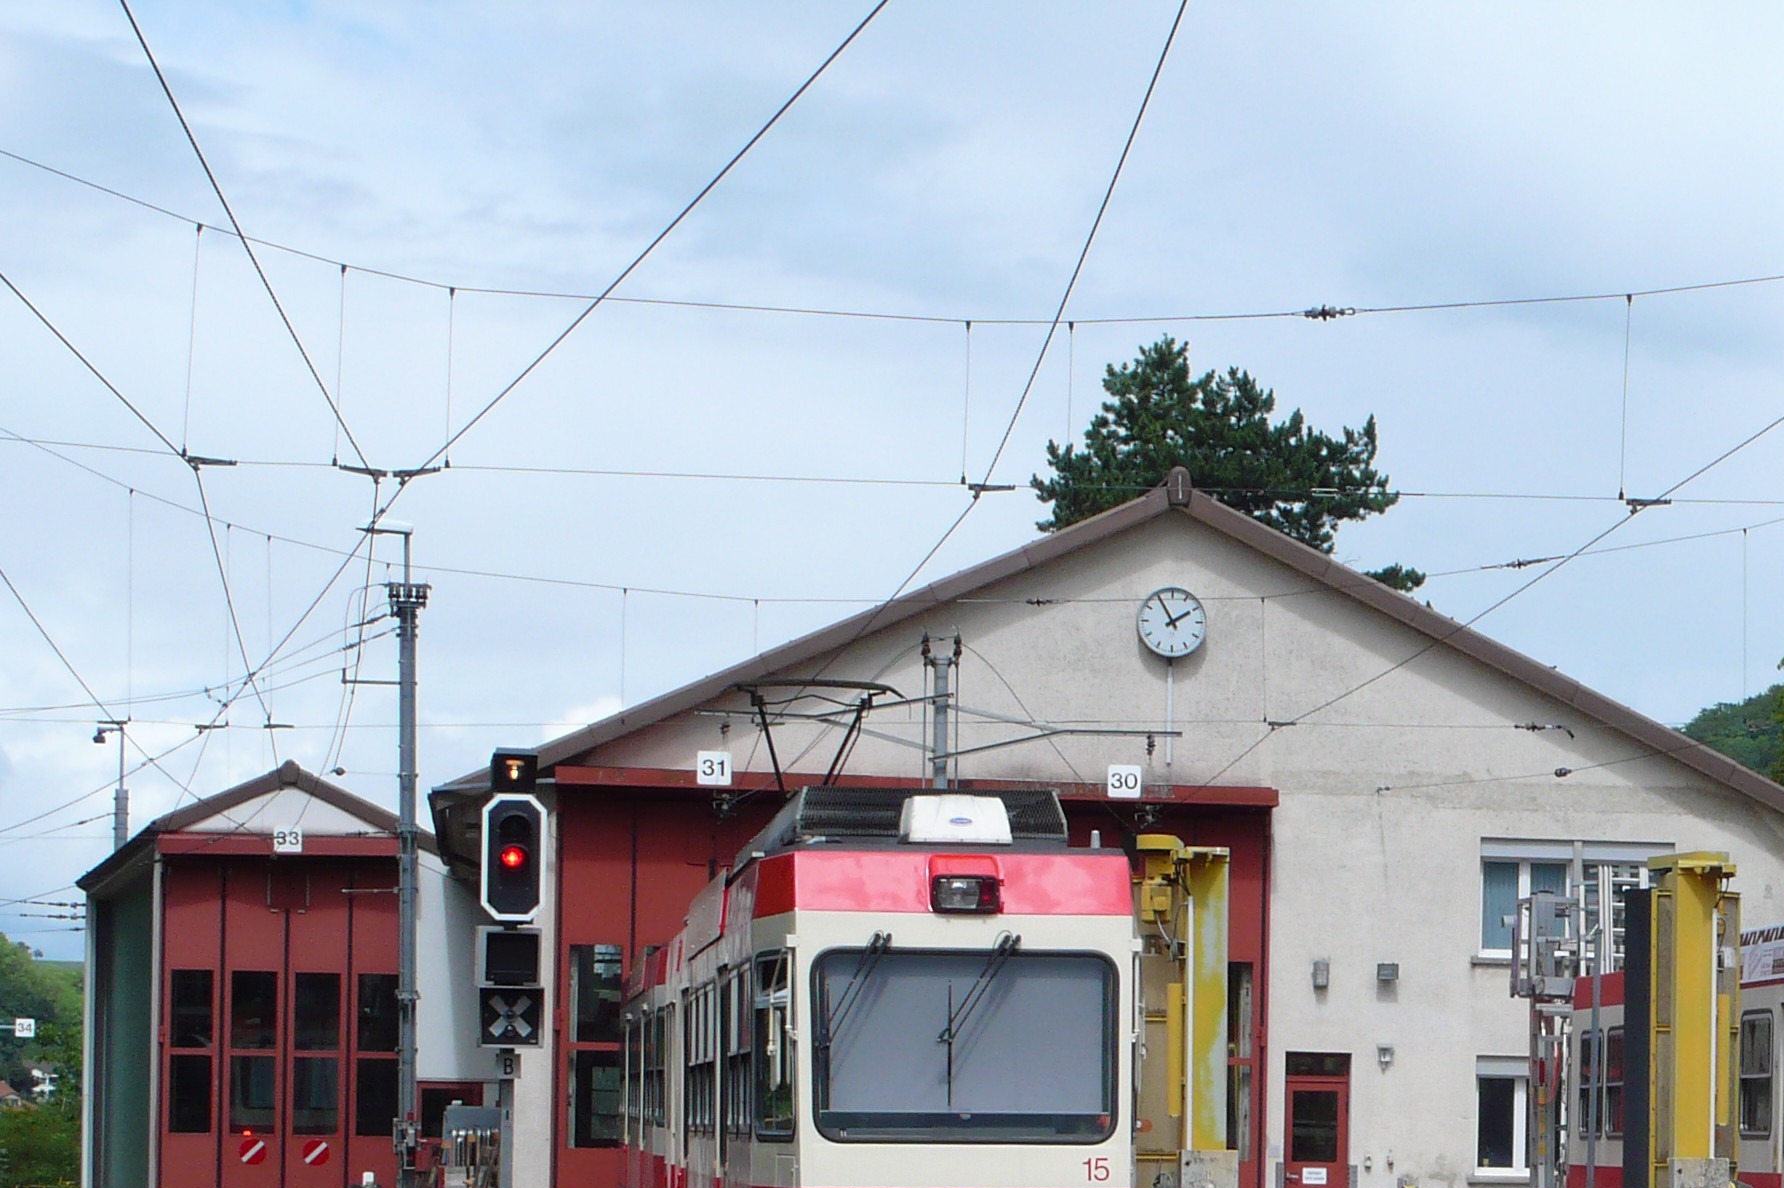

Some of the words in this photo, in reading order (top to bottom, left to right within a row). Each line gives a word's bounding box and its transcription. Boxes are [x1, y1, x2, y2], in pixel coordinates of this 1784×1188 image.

[702, 759, 725, 777] 31
[1110, 772, 1138, 790] 30
[276, 830, 300, 846] 33
[17, 1022, 32, 1033] 34
[503, 1057, 514, 1075] B
[1081, 1157, 1110, 1182] 15
